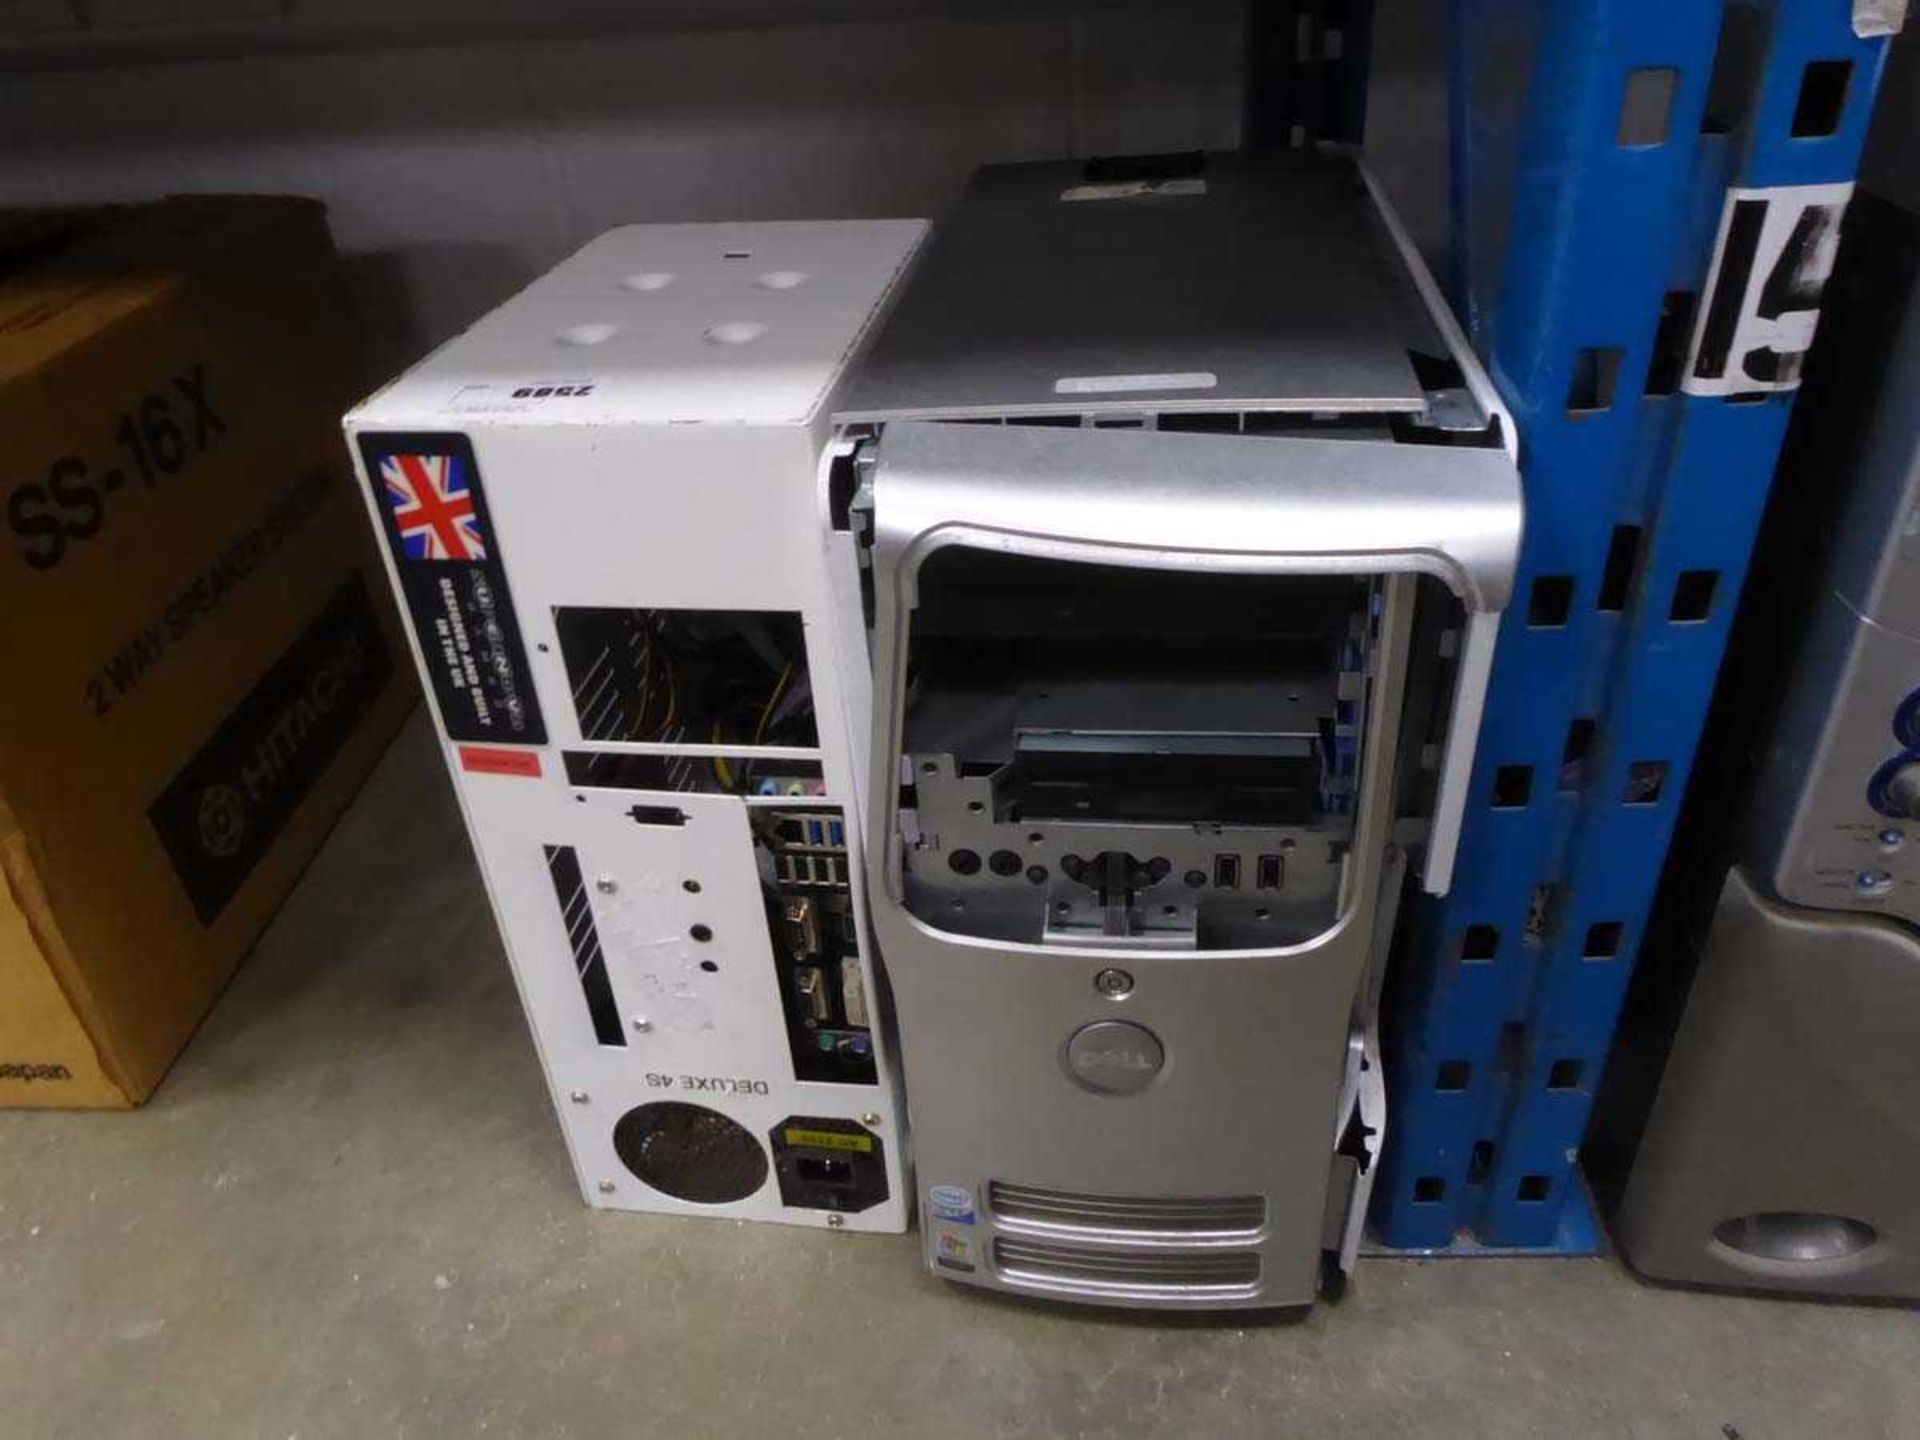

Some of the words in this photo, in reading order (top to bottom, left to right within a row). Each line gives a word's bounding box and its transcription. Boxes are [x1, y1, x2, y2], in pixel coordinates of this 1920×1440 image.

[433, 619, 450, 635] IN
[439, 578, 469, 651] DESIGNED
[459, 655, 481, 685] AND
[439, 638, 459, 665] THE
[85, 676, 112, 717] 2
[102, 622, 164, 693] WAY
[448, 667, 466, 688] UK
[240, 624, 365, 800] HITACH
[1077, 1050, 1153, 1070] DELL
[645, 1072, 673, 1088] 4S
[679, 1074, 769, 1095] DELUXE
